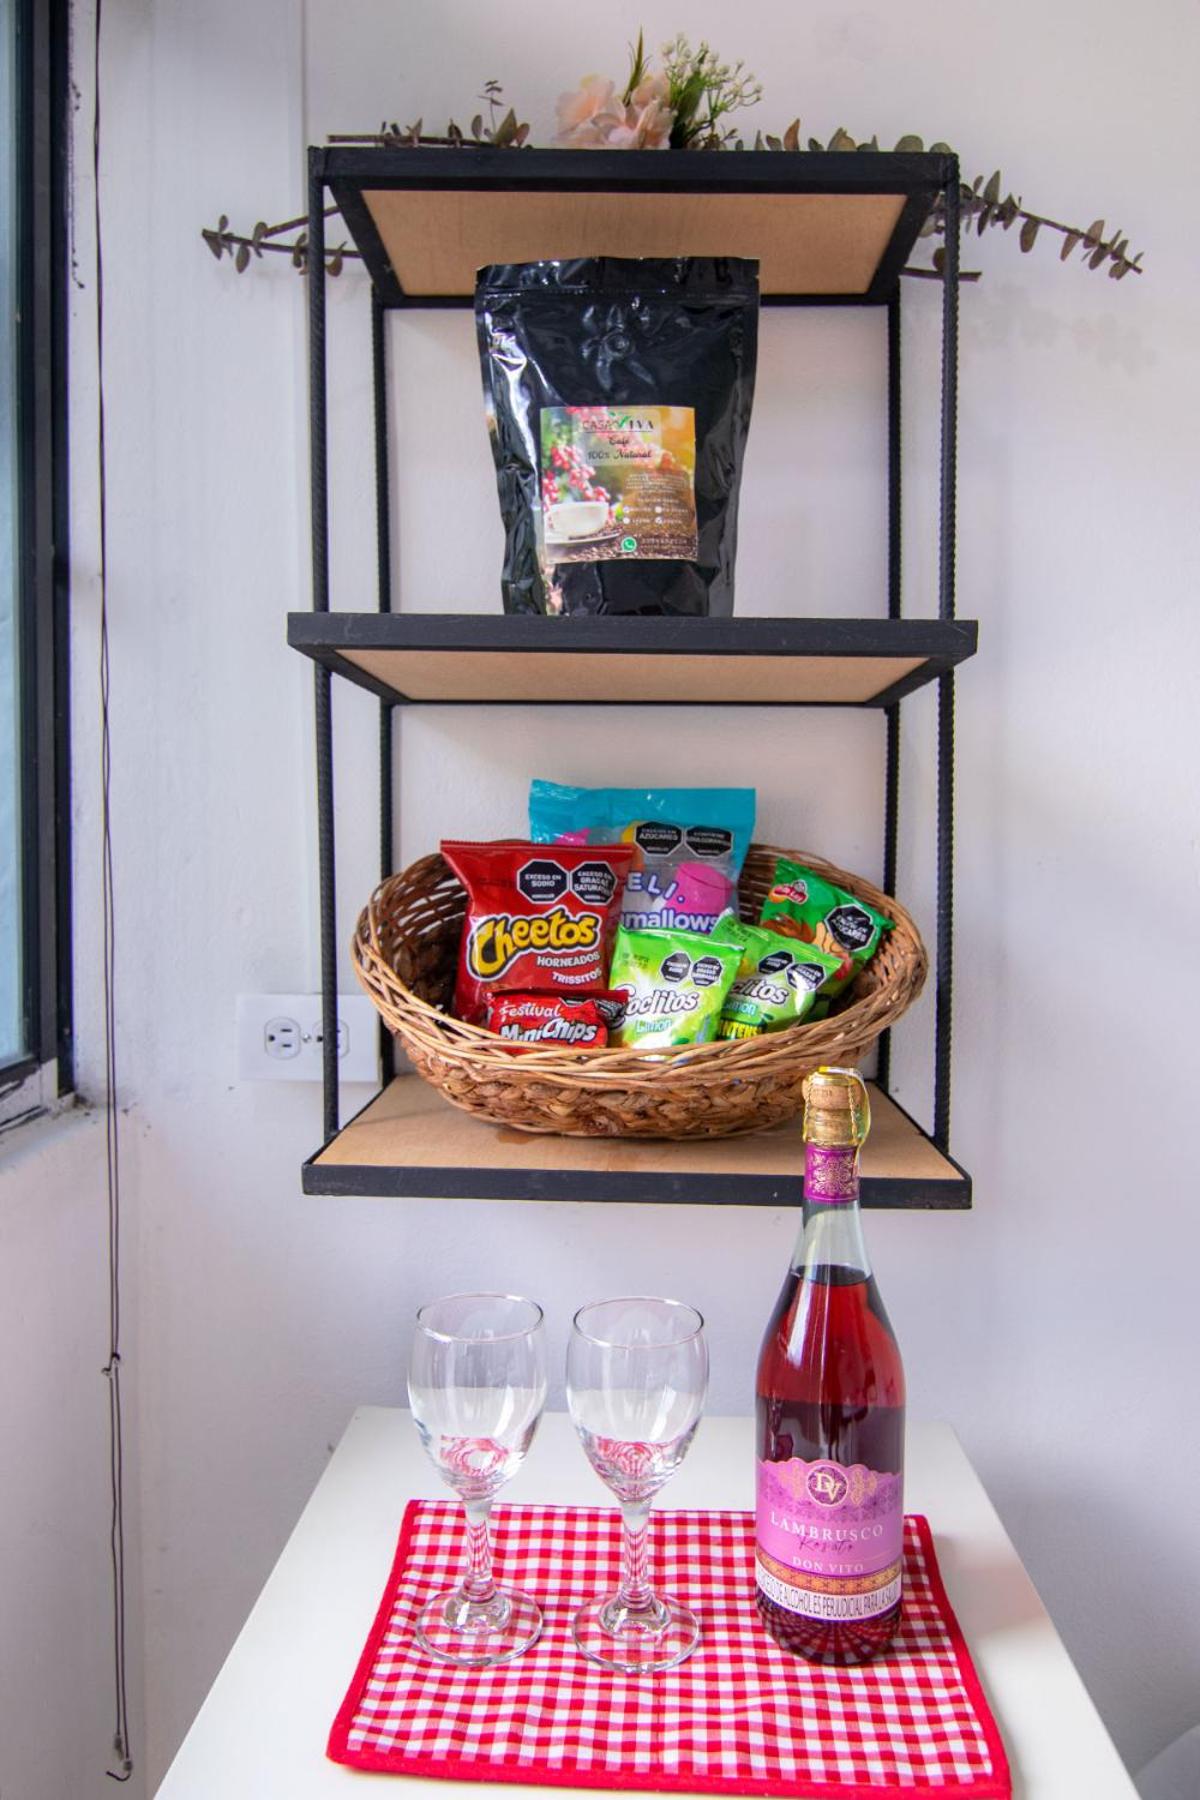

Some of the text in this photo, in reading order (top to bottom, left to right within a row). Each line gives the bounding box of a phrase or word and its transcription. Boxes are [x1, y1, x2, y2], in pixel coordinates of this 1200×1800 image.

[613, 450, 653, 461] Natural
[531, 880, 556, 888] SODIO
[621, 908, 718, 932] mallows
[470, 908, 599, 978] Cheetos
[537, 952, 600, 967] HORNEADOS
[500, 1000, 561, 1023] Festival
[770, 1511, 884, 1542] LAMBRUSCO
[792, 1556, 864, 1575] DON VITO
